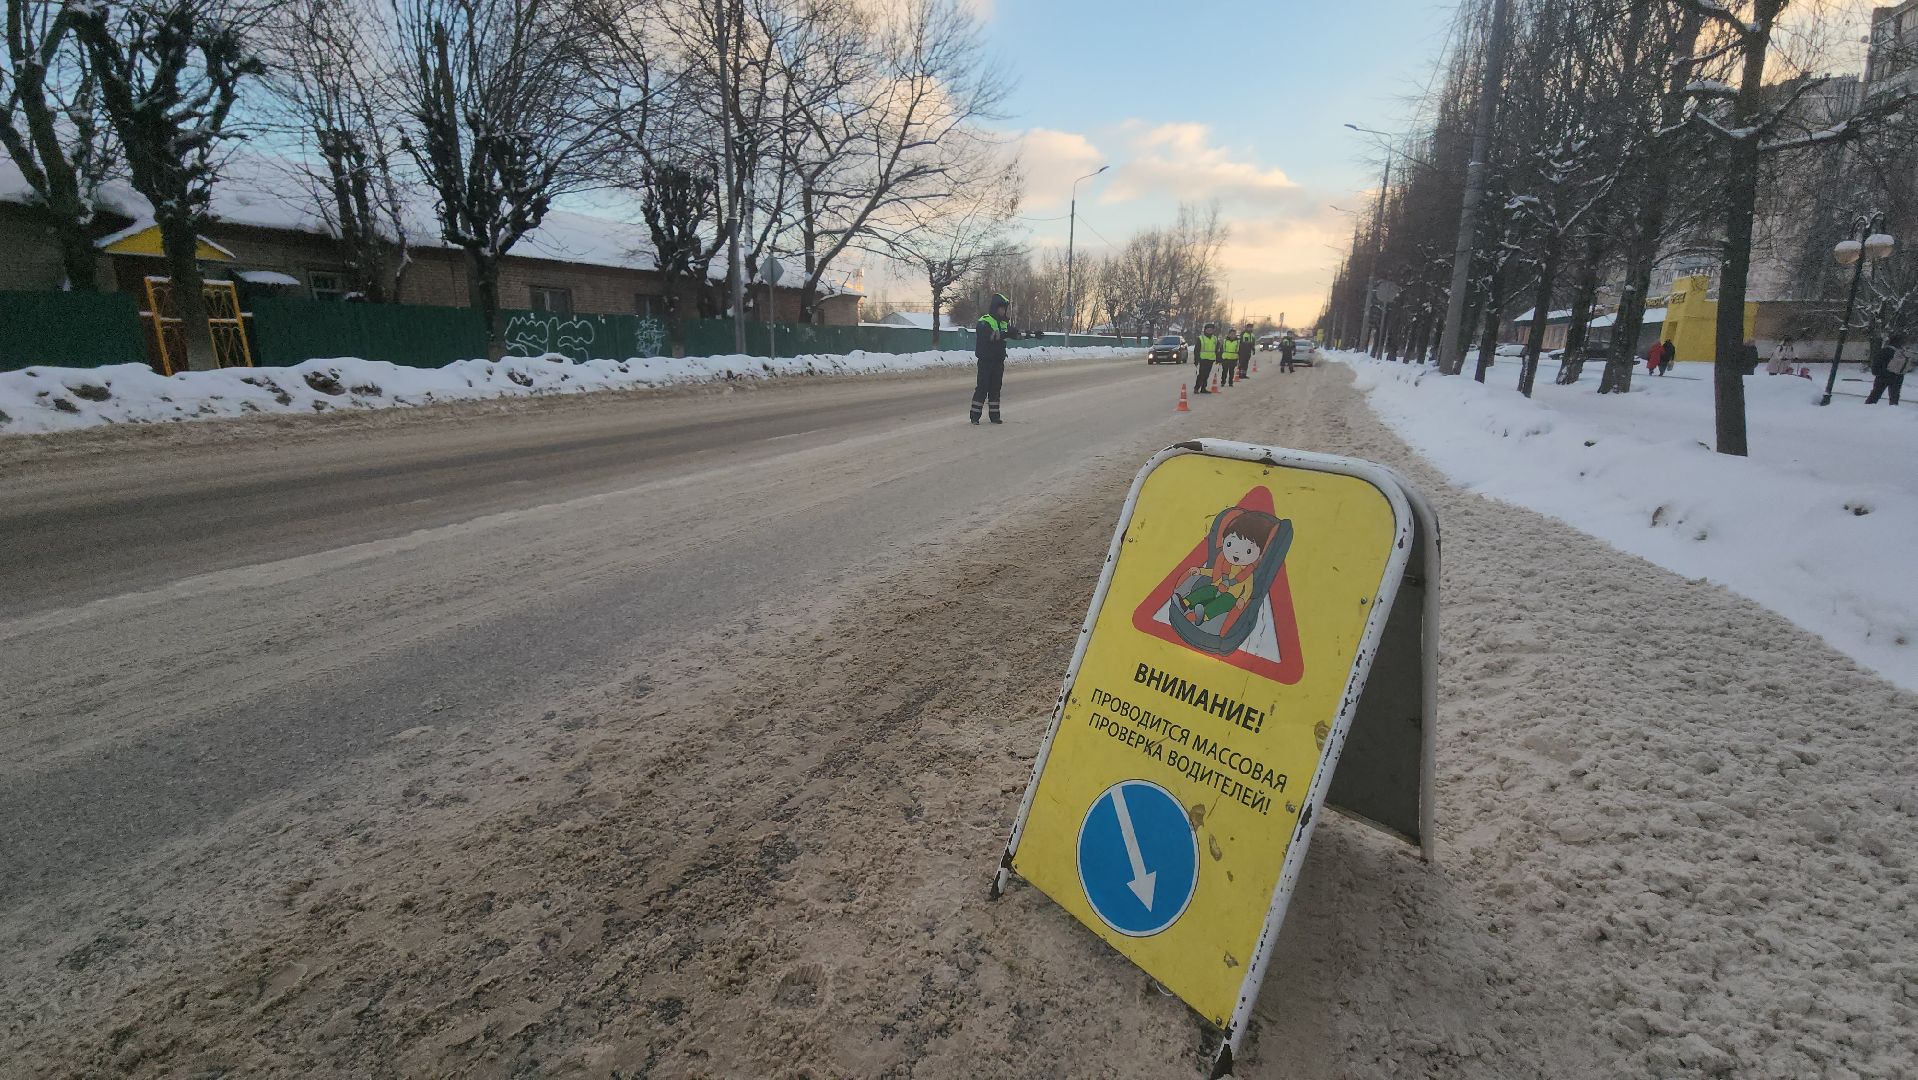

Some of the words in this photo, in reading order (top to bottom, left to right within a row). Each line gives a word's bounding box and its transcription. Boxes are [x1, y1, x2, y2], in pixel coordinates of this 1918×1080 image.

[1090, 688, 1190, 746] ПРОВОДИТСЯ
[1191, 734, 1288, 793] МАССОВАЯ
[1133, 662, 1266, 734] ВНИМАНИЕ!
[1088, 712, 1163, 761] ПРОВЕРКА
[1166, 750, 1272, 816] ВОДИТЕЛЕЙ!
